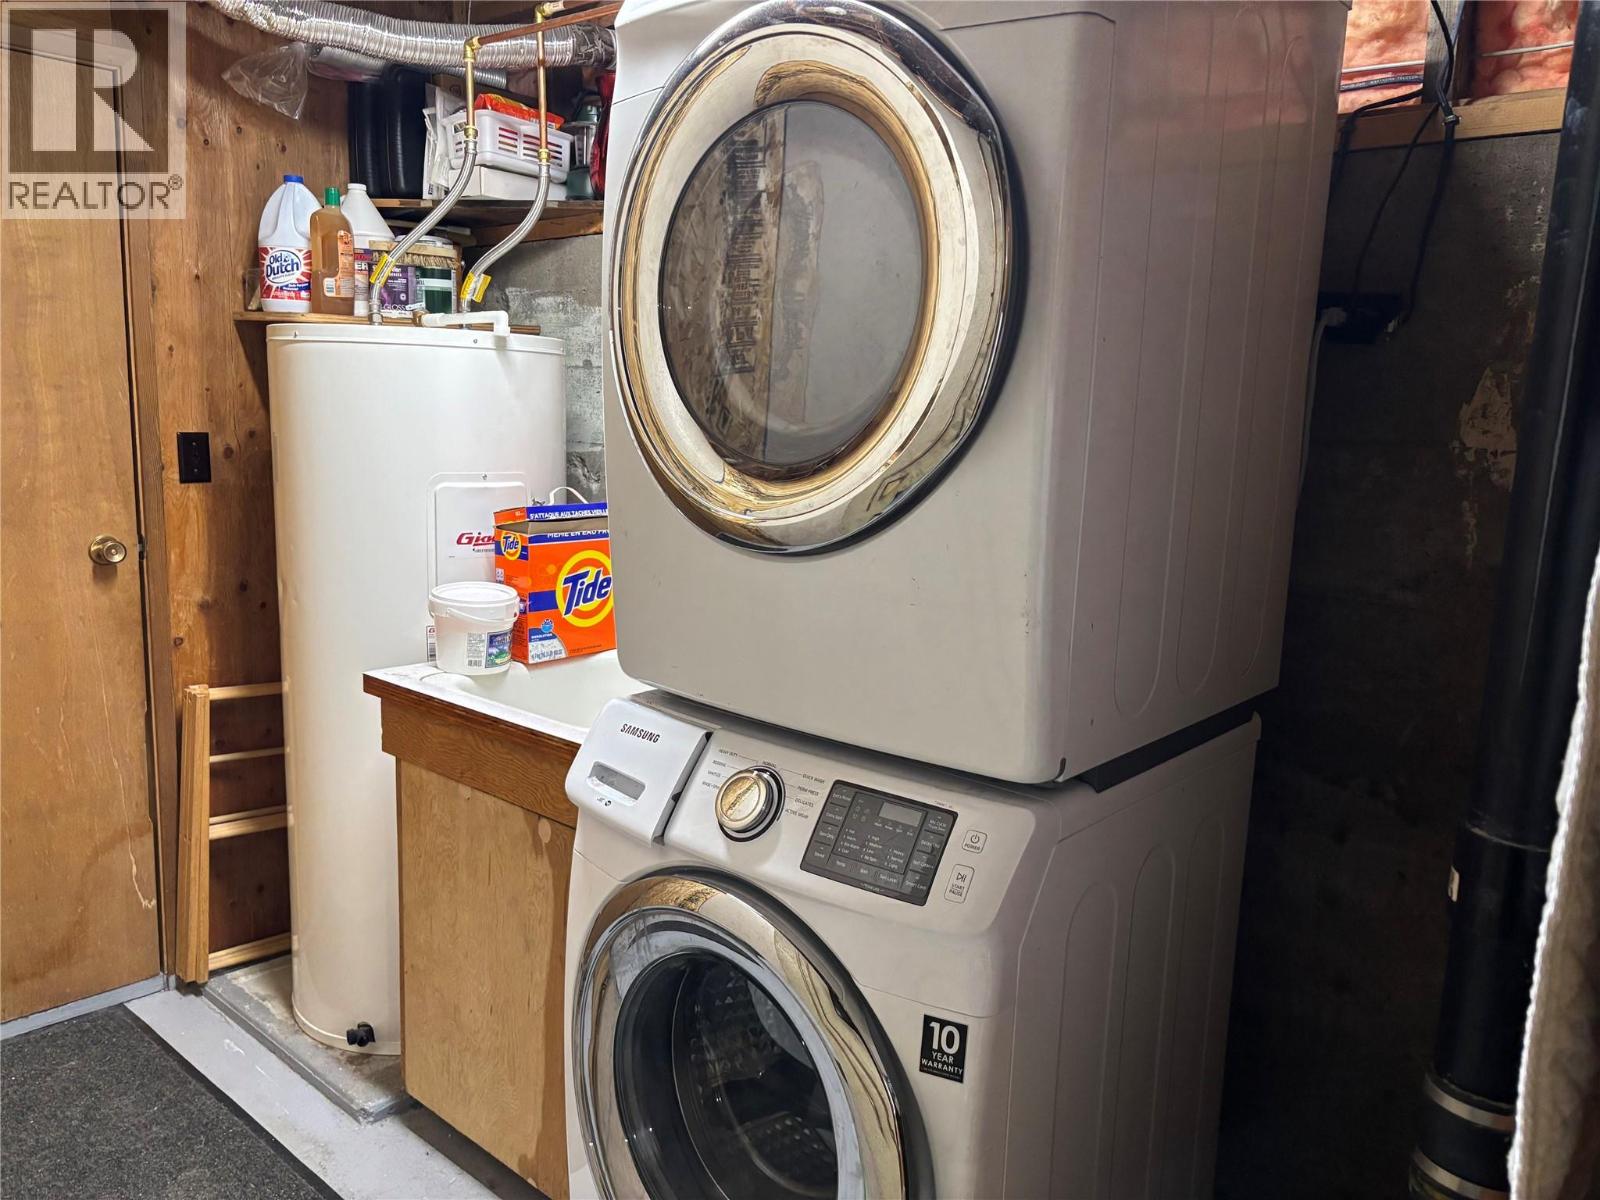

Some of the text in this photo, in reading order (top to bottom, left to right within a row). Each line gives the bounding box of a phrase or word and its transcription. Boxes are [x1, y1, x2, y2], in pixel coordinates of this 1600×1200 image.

[269, 252, 282, 264] Old
[265, 258, 299, 278] Dutch
[502, 534, 519, 553] Tide
[562, 568, 613, 617] Tide
[620, 723, 660, 743] SAMSUNG
[929, 1021, 960, 1055] 10
[921, 1058, 963, 1074] WARRANTY
[931, 1051, 954, 1065] YEAR
